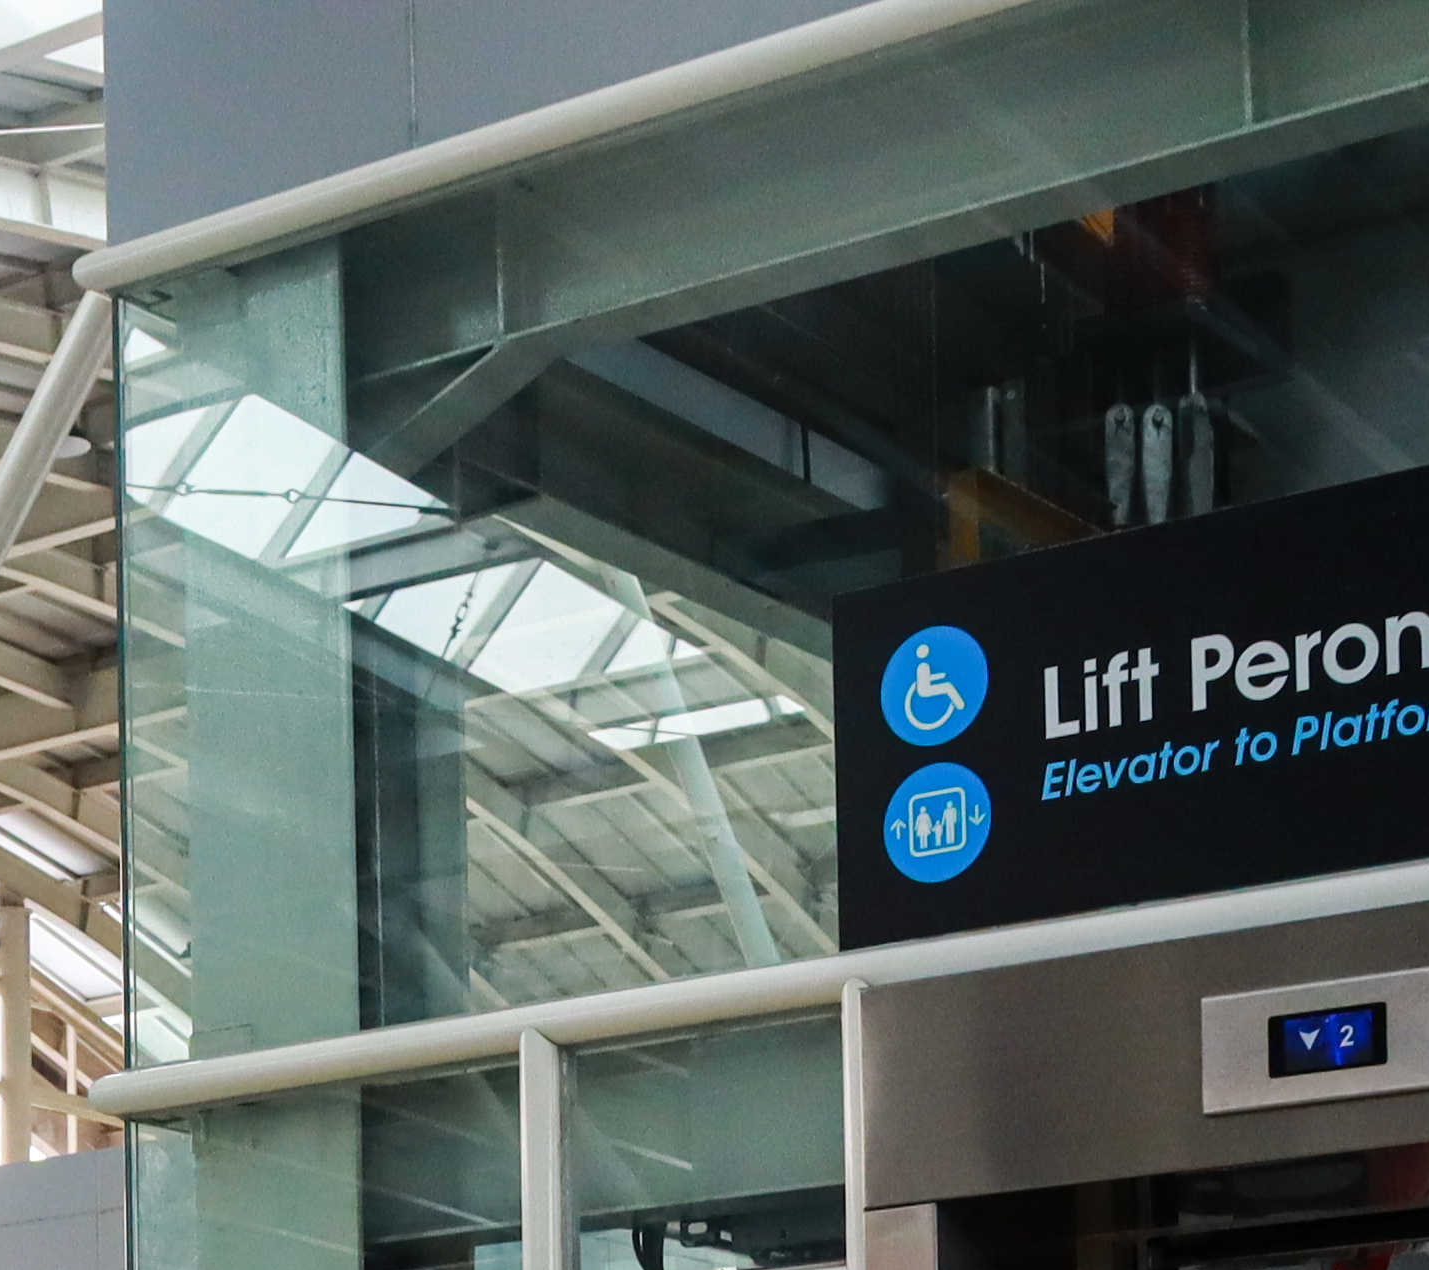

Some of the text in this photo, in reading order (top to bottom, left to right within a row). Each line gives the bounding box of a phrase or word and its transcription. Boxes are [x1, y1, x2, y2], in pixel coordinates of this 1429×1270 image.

[1044, 648, 1159, 739] Lift
[1042, 740, 1219, 800] Elevator
[1235, 728, 1277, 766] to
[1340, 1025, 1354, 1047] 2
